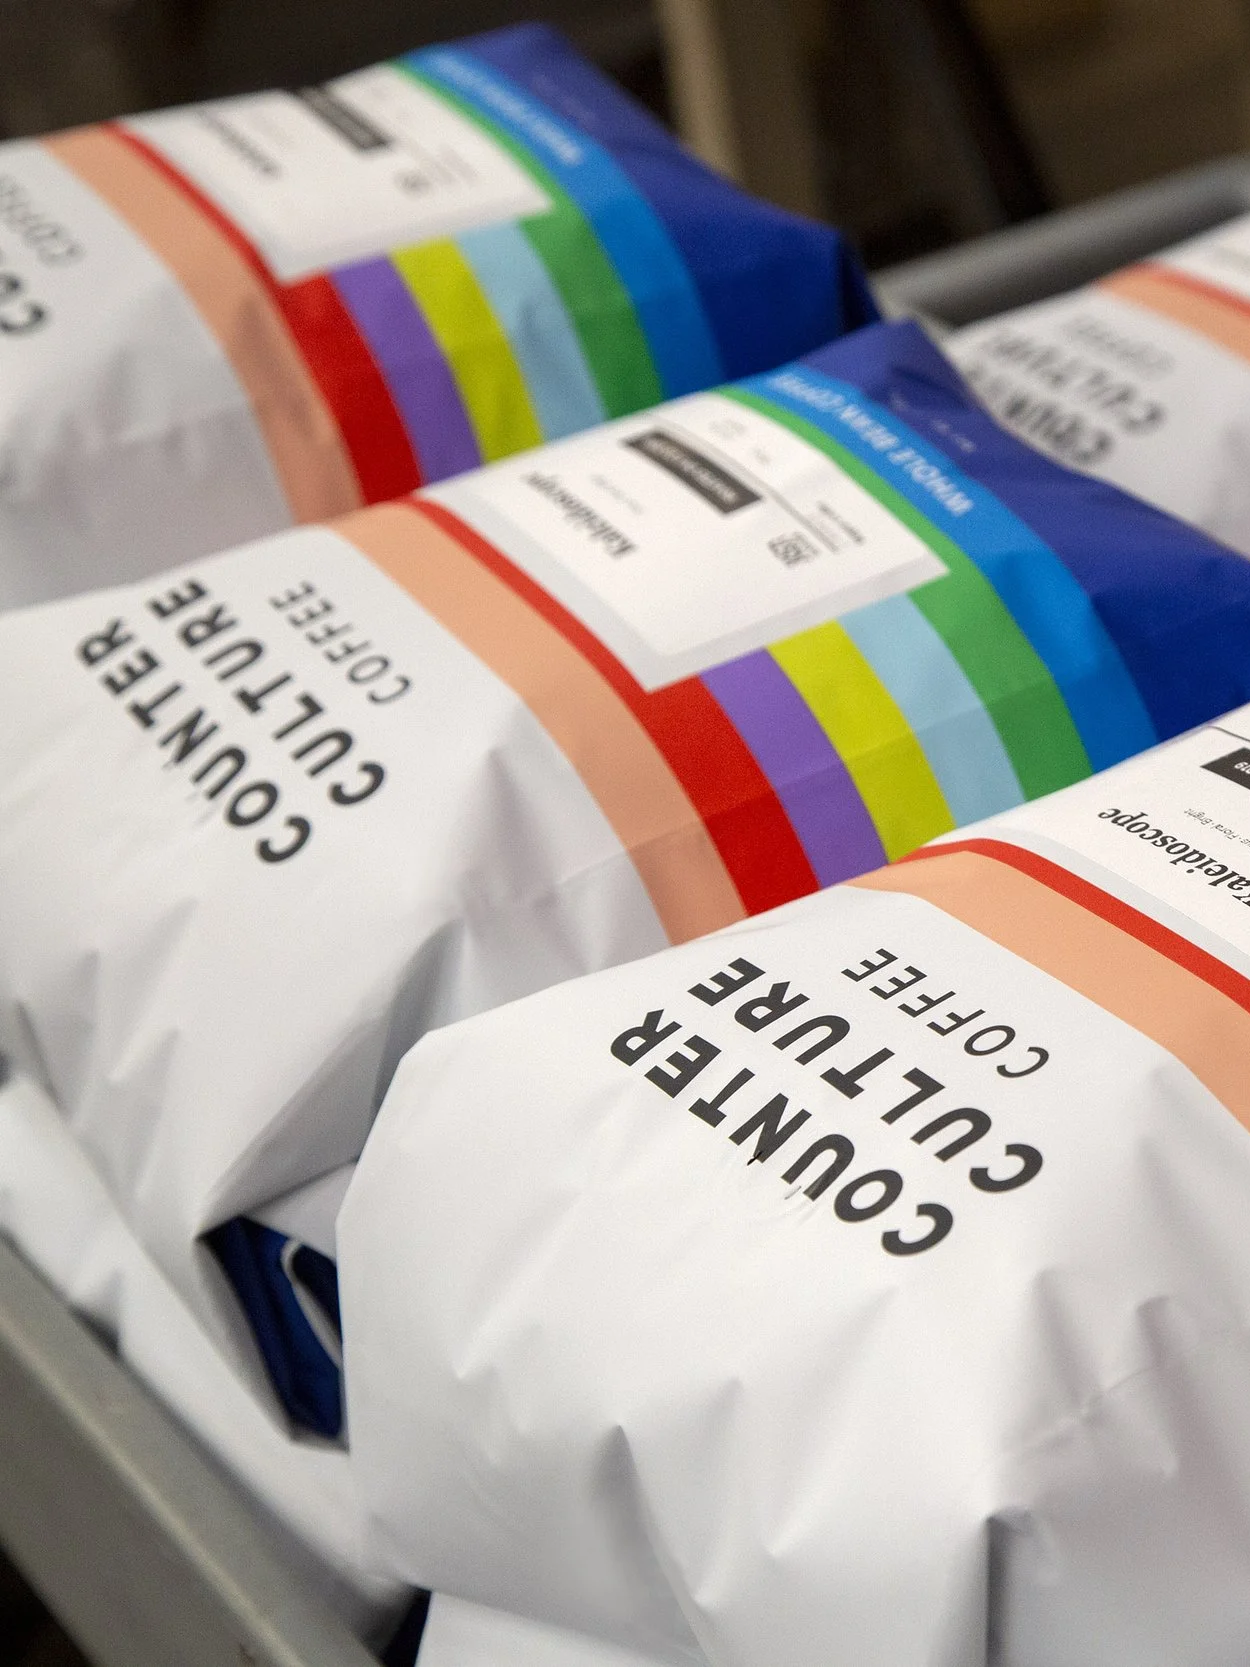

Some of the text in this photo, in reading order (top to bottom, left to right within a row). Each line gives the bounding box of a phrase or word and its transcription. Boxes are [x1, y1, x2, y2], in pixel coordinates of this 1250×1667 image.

[74, 616, 313, 865] COUNTER
[145, 577, 386, 806] CULTURE
[268, 579, 412, 706] COFFEE
[687, 957, 1044, 1193] CULTURE
[841, 947, 1051, 1078] COFFEE
[609, 1008, 954, 1257] COUNTER
